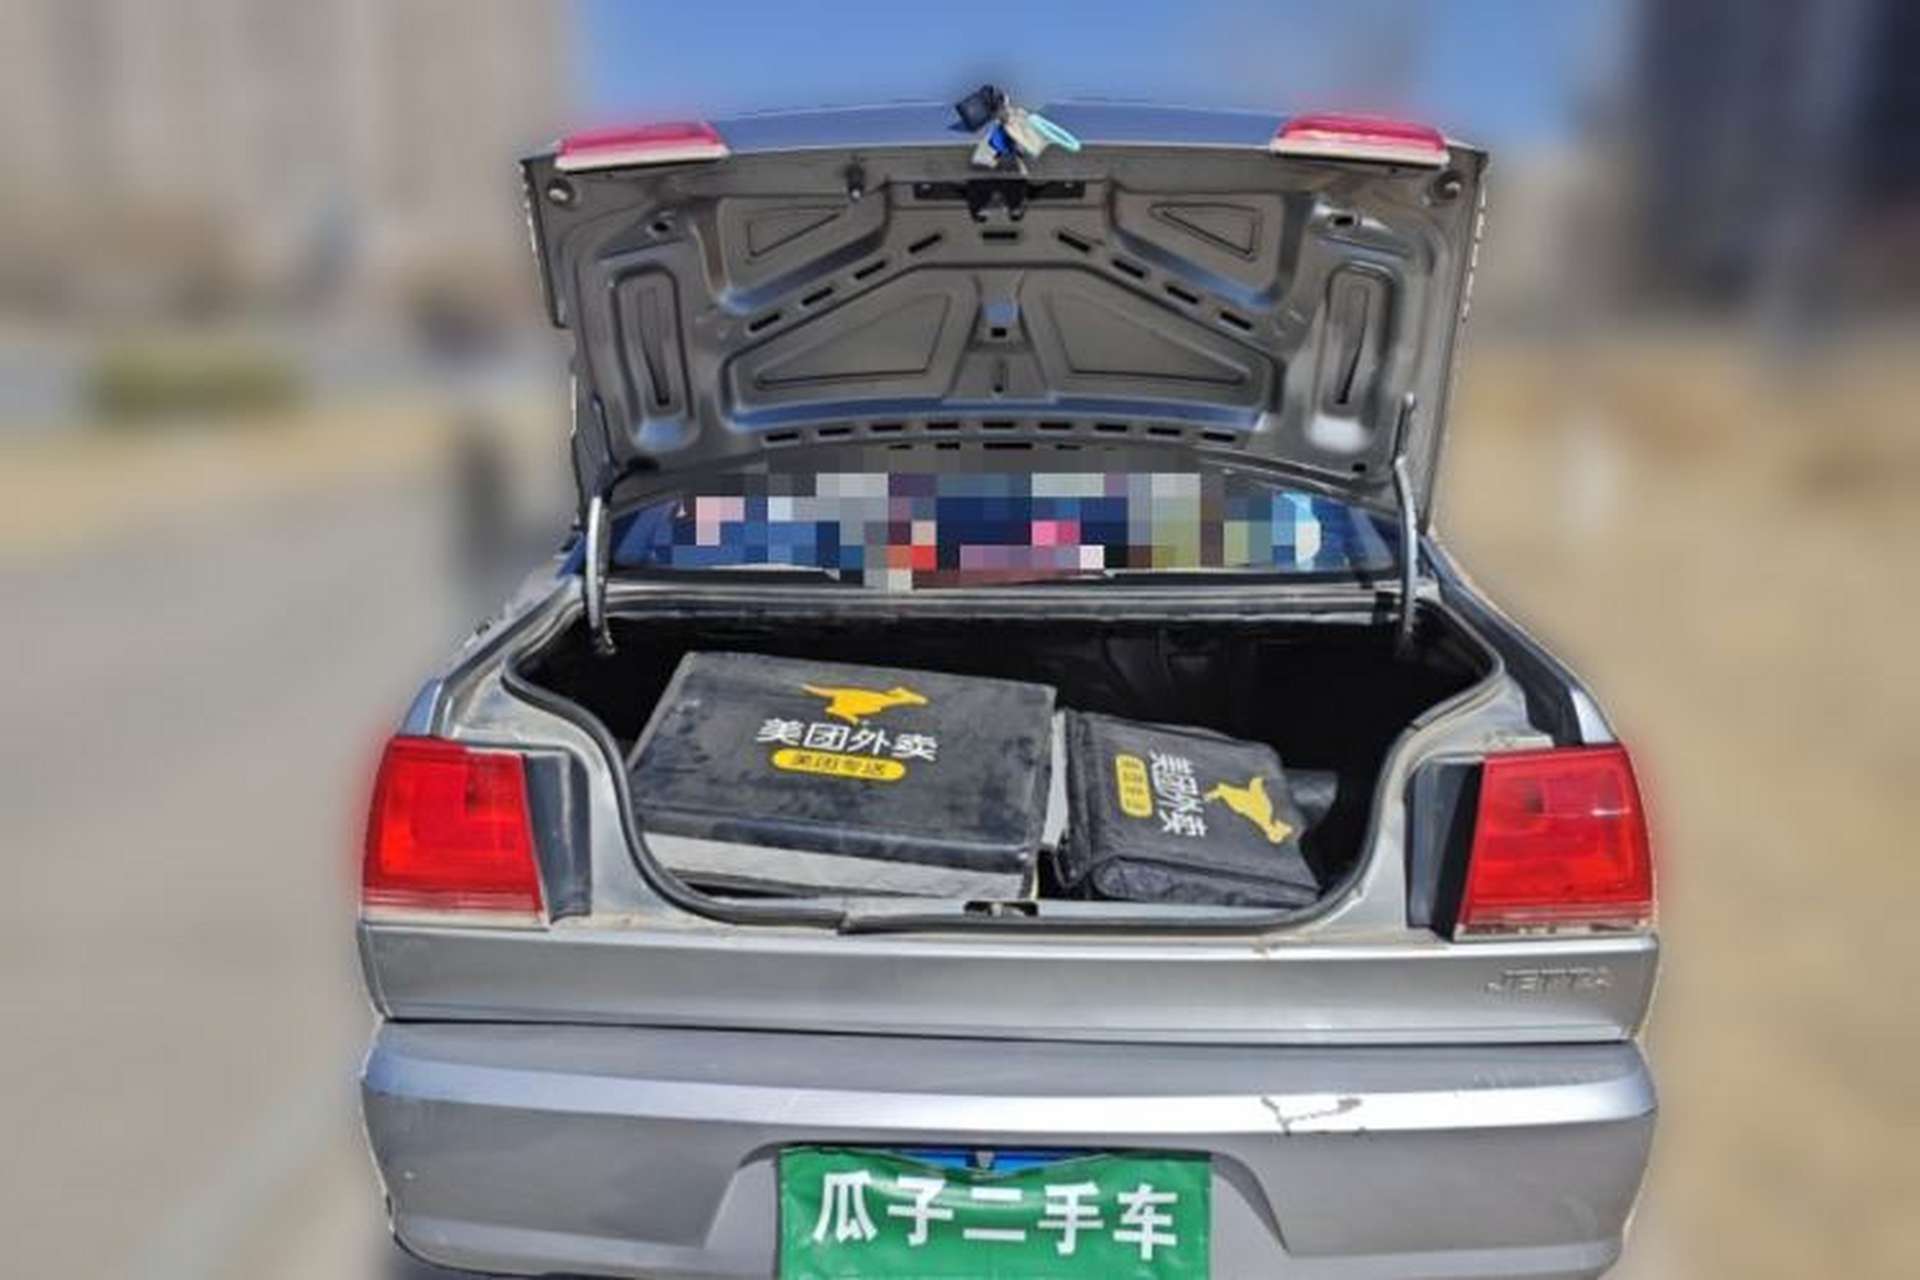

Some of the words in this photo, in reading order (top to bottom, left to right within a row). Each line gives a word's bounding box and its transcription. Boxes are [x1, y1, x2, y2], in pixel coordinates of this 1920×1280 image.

[756, 717, 940, 762] 美团外卖
[812, 1169, 1178, 1261] 瓜子二手车
